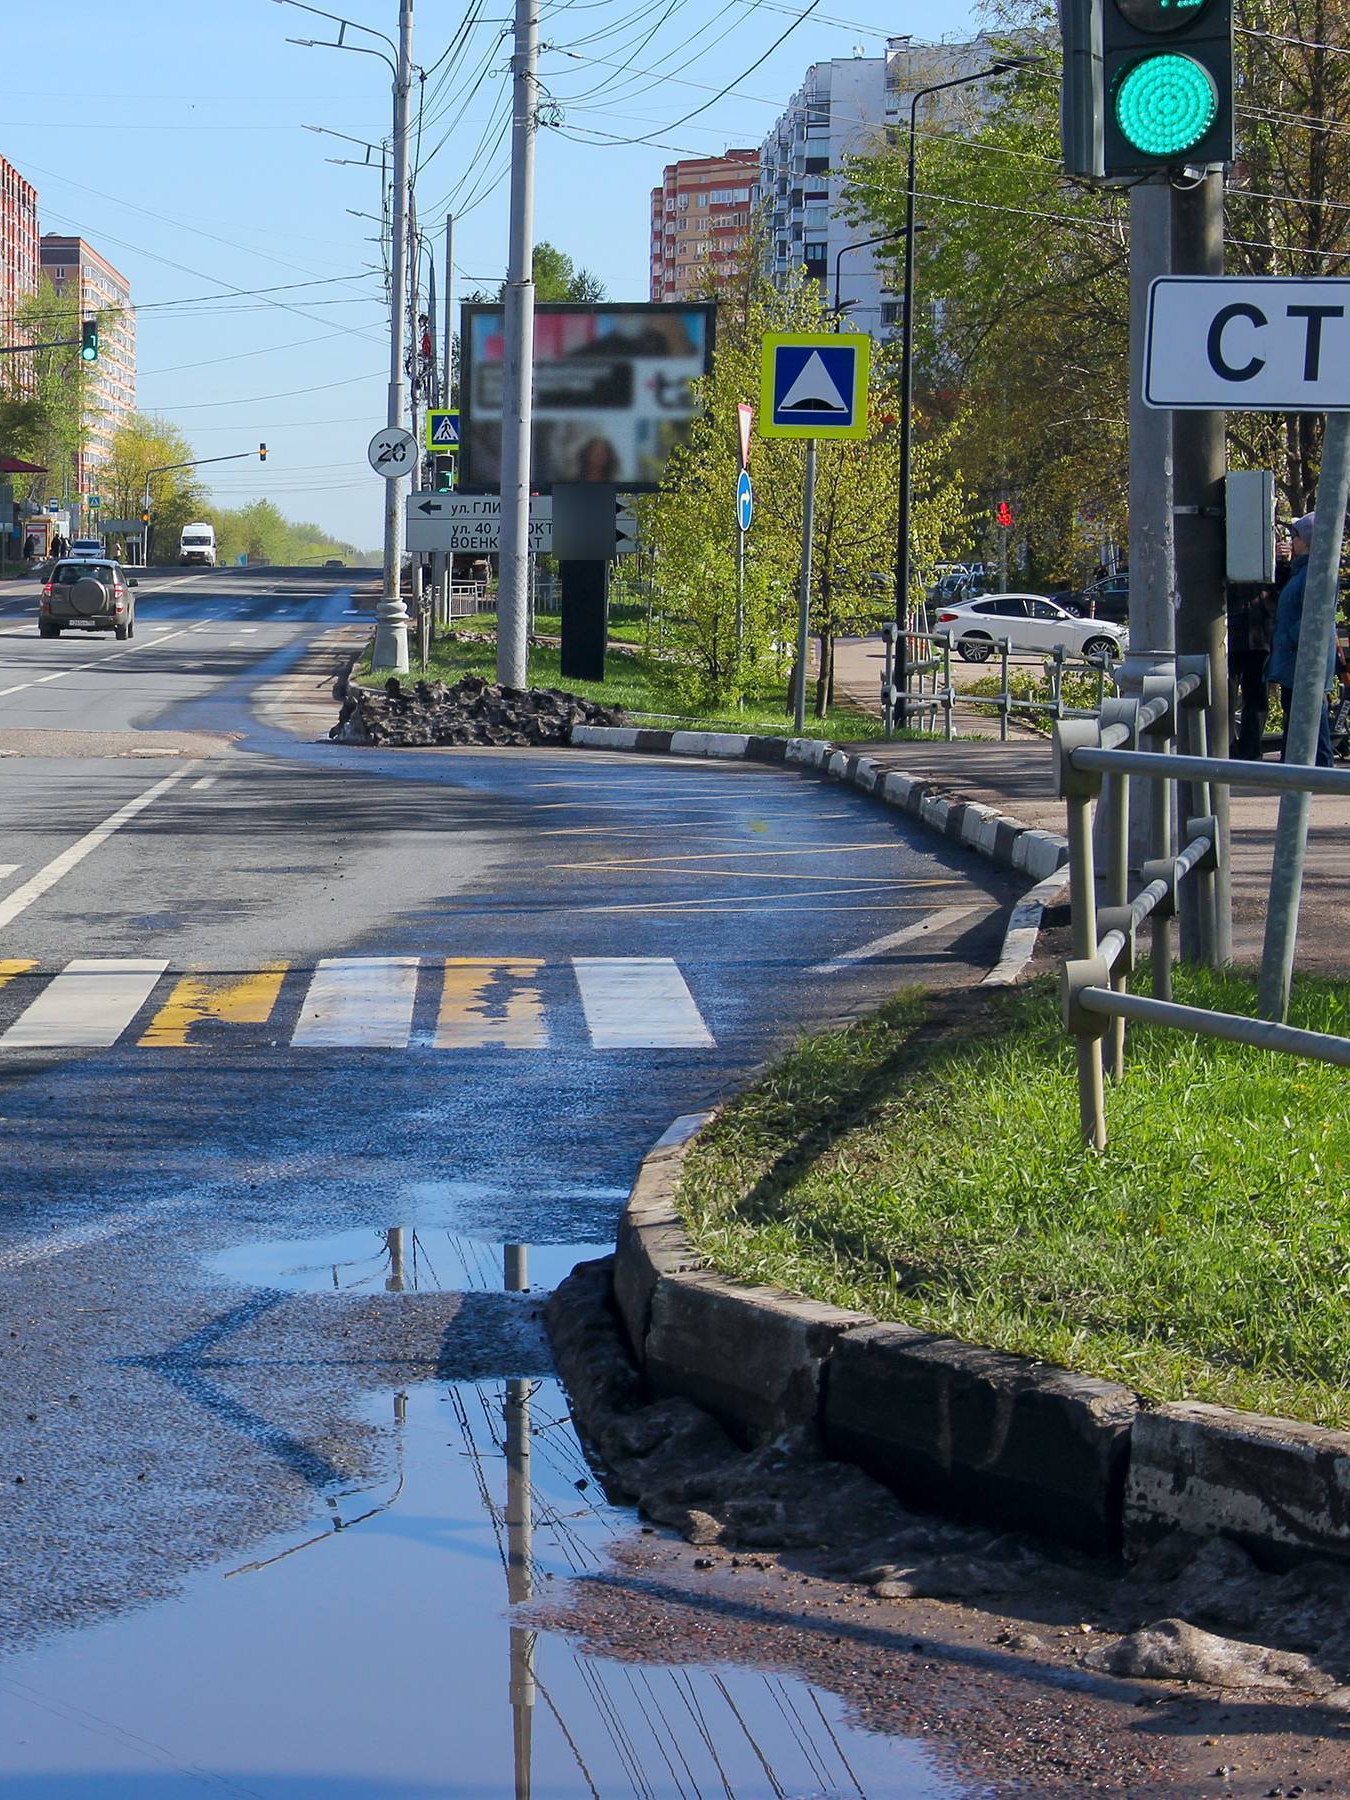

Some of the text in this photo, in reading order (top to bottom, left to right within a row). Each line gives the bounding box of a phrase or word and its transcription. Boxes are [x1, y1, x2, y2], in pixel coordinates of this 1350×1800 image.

[377, 442, 407, 462] 20
[451, 504, 470, 517] ул.
[451, 525, 471, 537] ул.
[474, 522, 492, 534] 40
